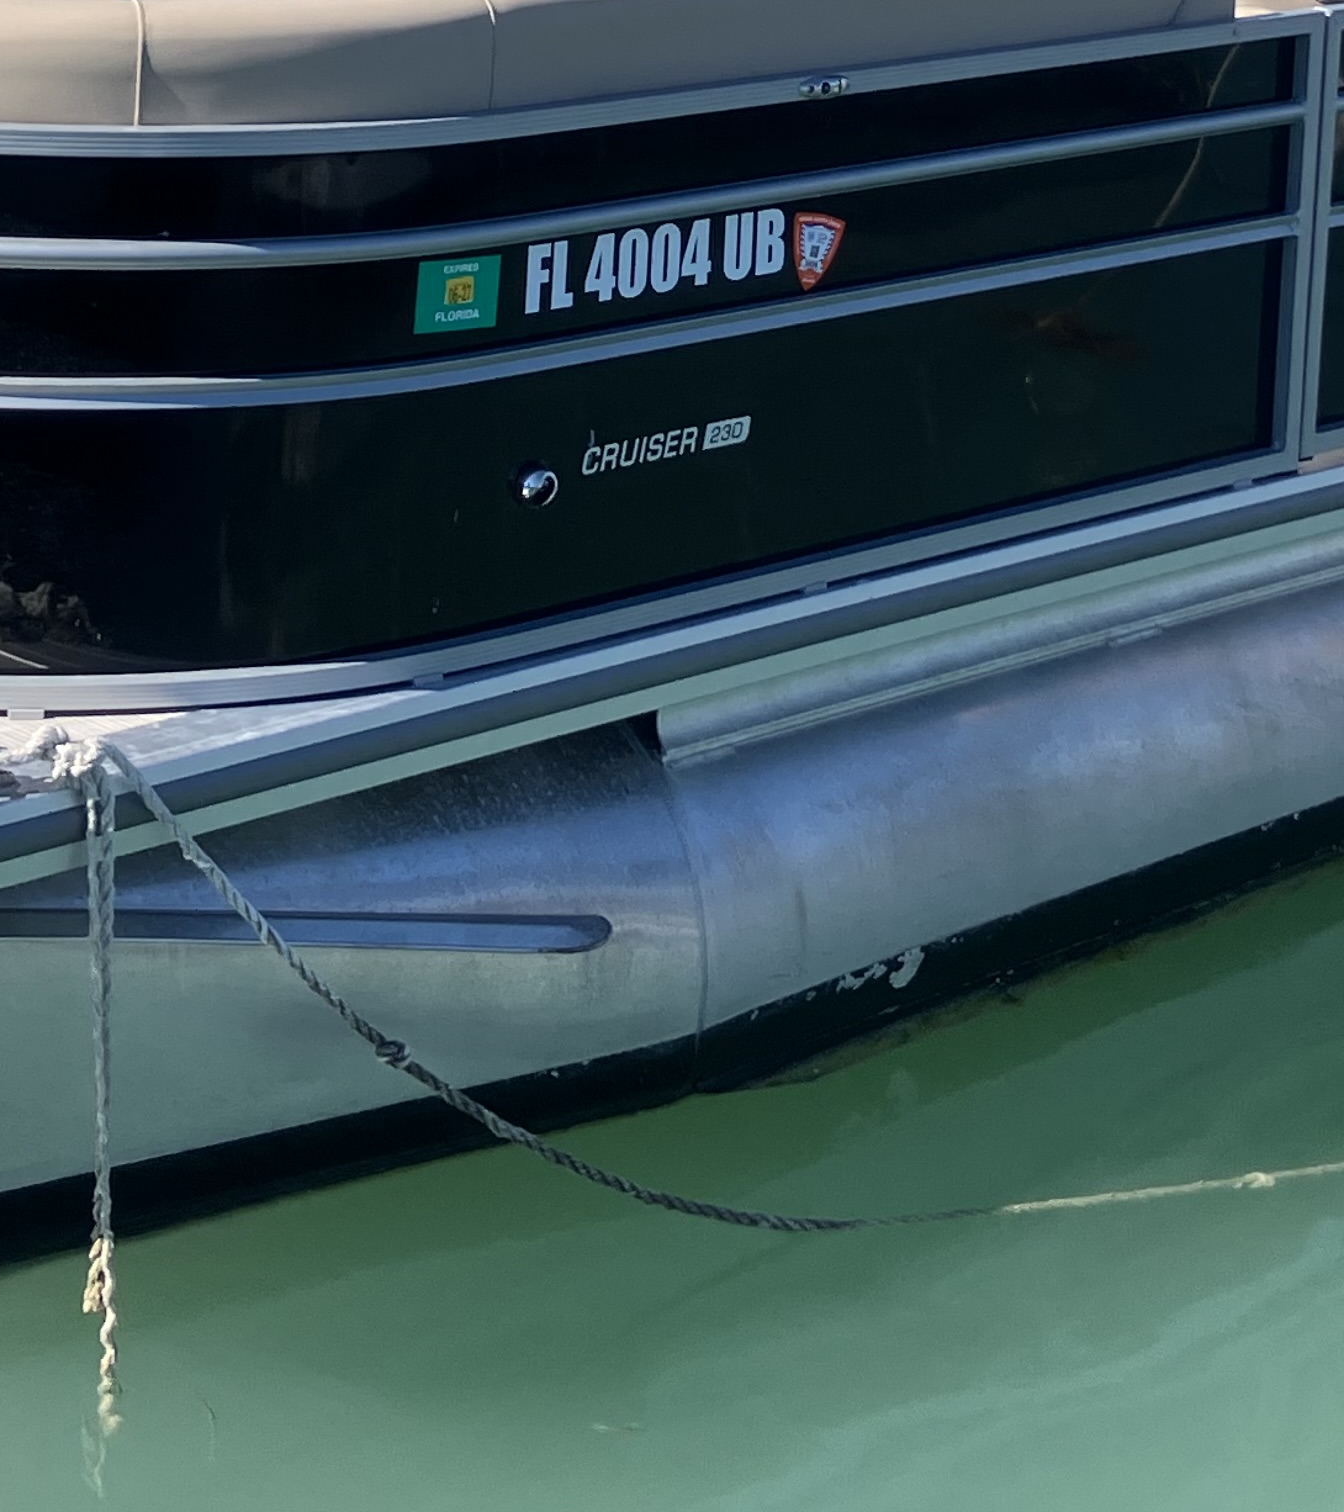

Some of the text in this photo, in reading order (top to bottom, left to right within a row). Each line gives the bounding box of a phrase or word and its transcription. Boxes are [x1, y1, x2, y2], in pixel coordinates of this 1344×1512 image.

[524, 208, 786, 315] FL 4004 UB
[434, 308, 480, 322] FLORIDA
[581, 420, 745, 476] CRUISER 230
